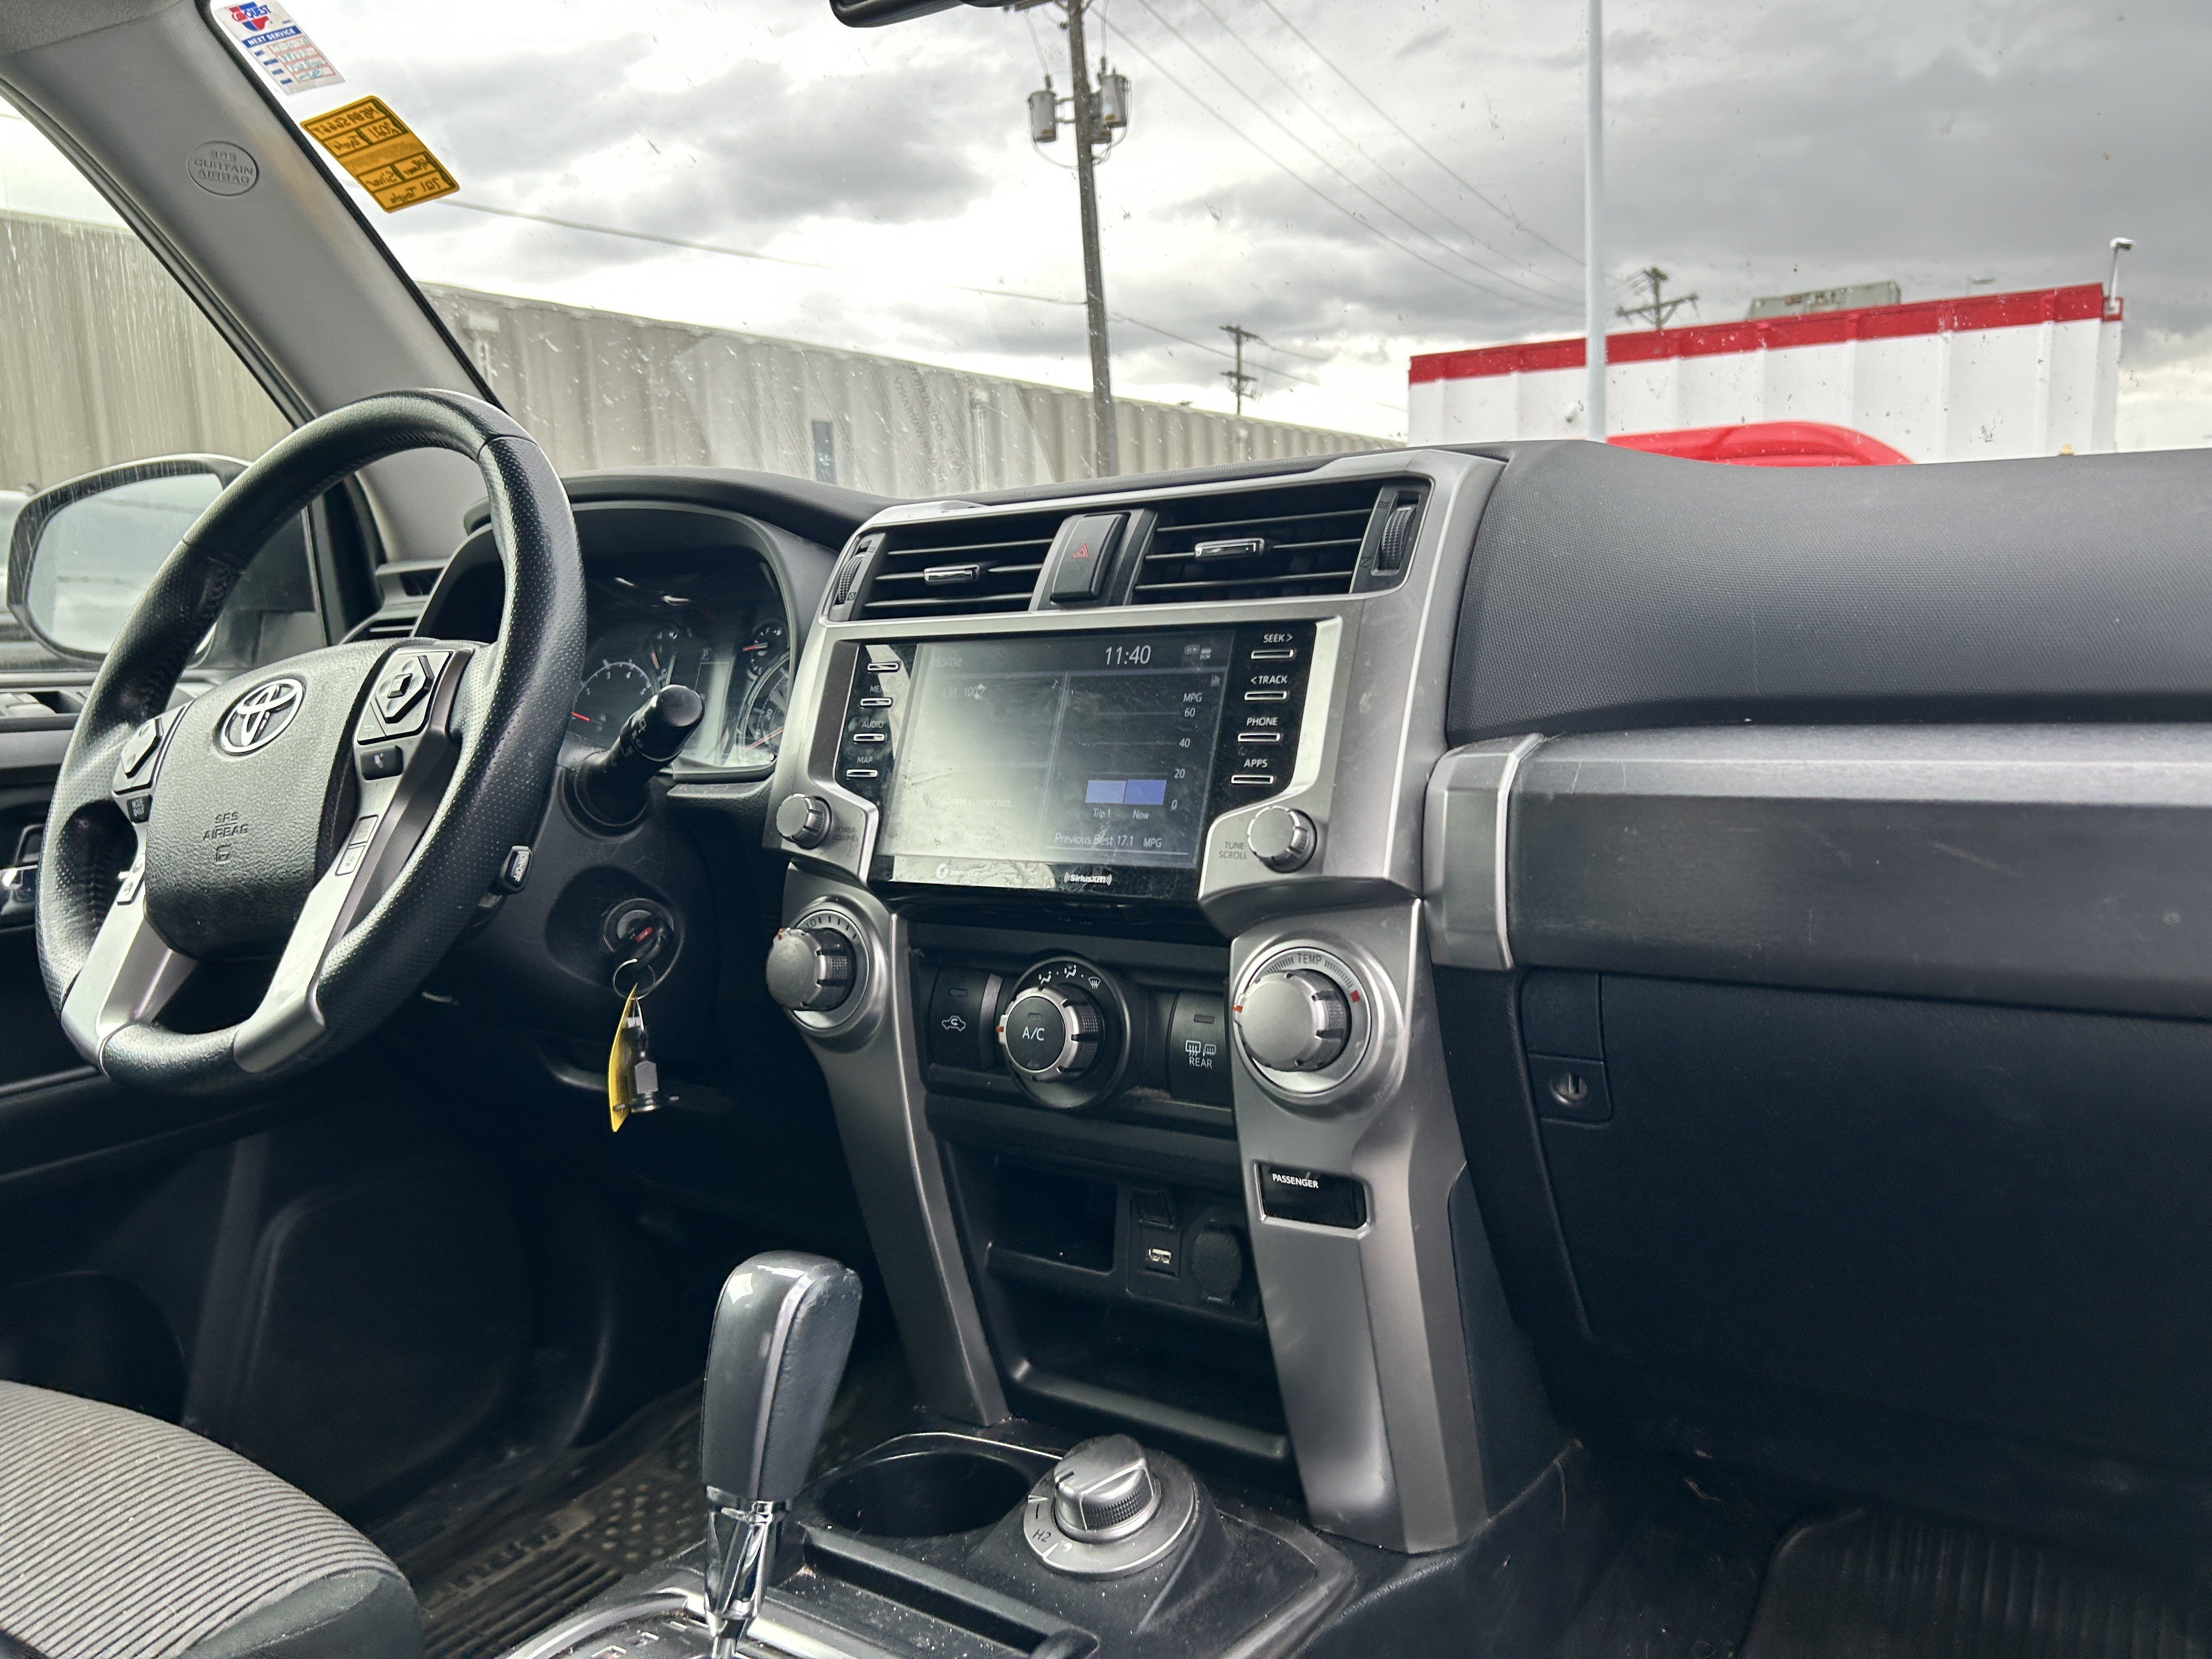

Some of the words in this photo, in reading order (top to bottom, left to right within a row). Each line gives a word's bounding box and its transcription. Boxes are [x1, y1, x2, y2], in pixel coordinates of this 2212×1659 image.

[247, 36, 267, 47] NEXT
[267, 28, 296, 41] SERVICE
[1105, 645, 1151, 665] 11:40
[1183, 692, 1203, 703] MPG
[1184, 708, 1196, 717] 60
[861, 720, 884, 729] AUDIO
[1246, 717, 1278, 726] PHONE
[1180, 738, 1190, 748] 40
[856, 756, 873, 764] MAP
[1243, 759, 1268, 768] APPS
[1174, 769, 1186, 779] 20
[1171, 800, 1178, 810] 0
[215, 811, 238, 823] SRS
[1093, 808, 1106, 819] Trip
[1107, 809, 1111, 817] 1
[1132, 810, 1149, 820] Now
[202, 823, 249, 840] AIRBAG
[1054, 832, 1091, 845] Previous
[1093, 834, 1113, 846] Best
[1117, 836, 1134, 847] 17.1
[1143, 837, 1163, 848] MPG
[1224, 841, 1244, 850] TUNE
[1218, 850, 1248, 860] SCROLL
[1297, 953, 1322, 966] TEMP
[1022, 1026, 1045, 1041] A/C
[1189, 1057, 1212, 1070] REAR
[1272, 1173, 1319, 1189] PASSENGER
